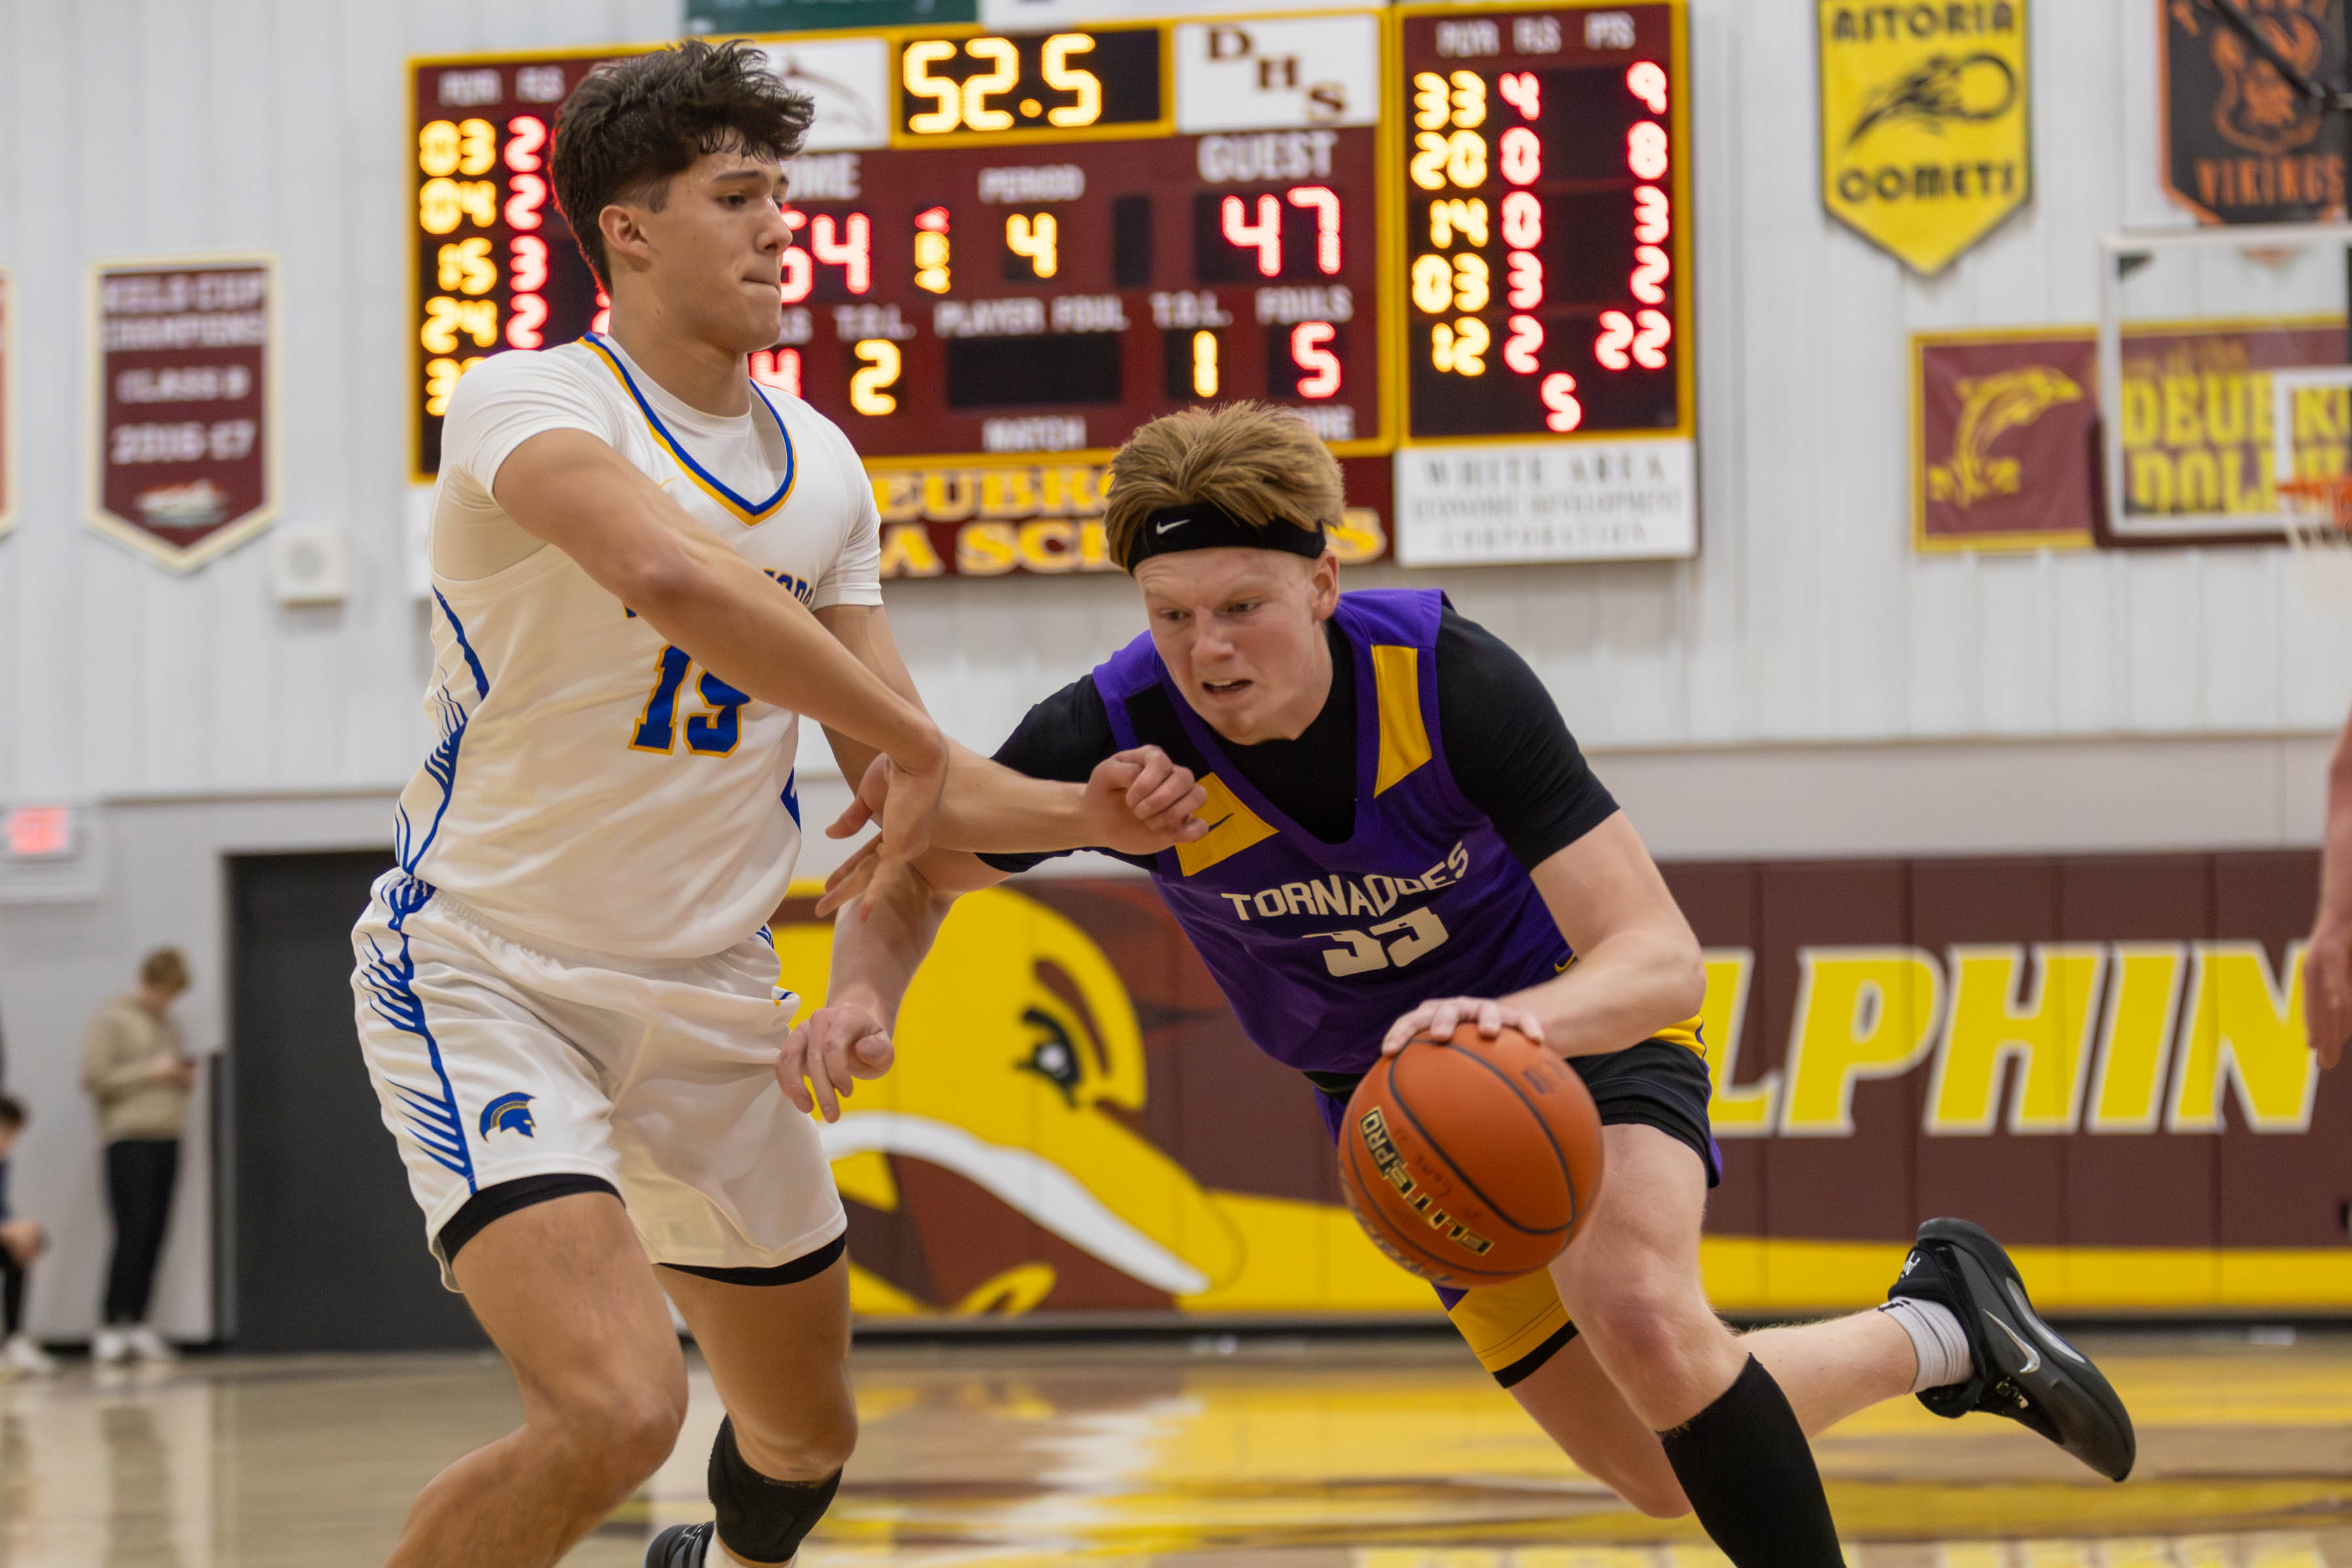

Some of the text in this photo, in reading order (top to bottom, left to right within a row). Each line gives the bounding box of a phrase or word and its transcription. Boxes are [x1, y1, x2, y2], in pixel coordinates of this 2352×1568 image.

[1833, 1, 2014, 42] ASTORIA
[903, 33, 1102, 134] 52.5
[1205, 25, 1348, 124] DHS
[1414, 61, 1667, 130] 33 4 9
[504, 115, 546, 171] 2
[1198, 132, 1338, 183] GUEST
[1411, 121, 1668, 190] 20 0 8
[504, 173, 547, 231] 2
[978, 164, 1085, 203] PERIOD
[1837, 162, 2014, 203] COMETS
[2195, 154, 2345, 206] VIKINGS
[1006, 213, 1057, 278] 4
[1222, 186, 1341, 276] 47
[1502, 191, 1542, 249] 0
[1633, 186, 1669, 244] 3
[438, 235, 548, 295] 15 3
[1412, 245, 1670, 314] 03 3 2
[421, 297, 497, 354] 24
[506, 293, 549, 350] 2
[933, 297, 1046, 338] PLAYER
[1255, 284, 1353, 324] FOULS
[1192, 330, 1218, 397] 1
[1291, 321, 1341, 399] 5
[1432, 309, 1671, 376] 12 2 22
[426, 356, 488, 416] 3
[851, 339, 901, 416] 2
[1541, 372, 1582, 432] 5
[984, 415, 1087, 452] MATCH
[1422, 451, 1667, 486] WHITE AREA
[1221, 840, 1469, 920] TORNADOES
